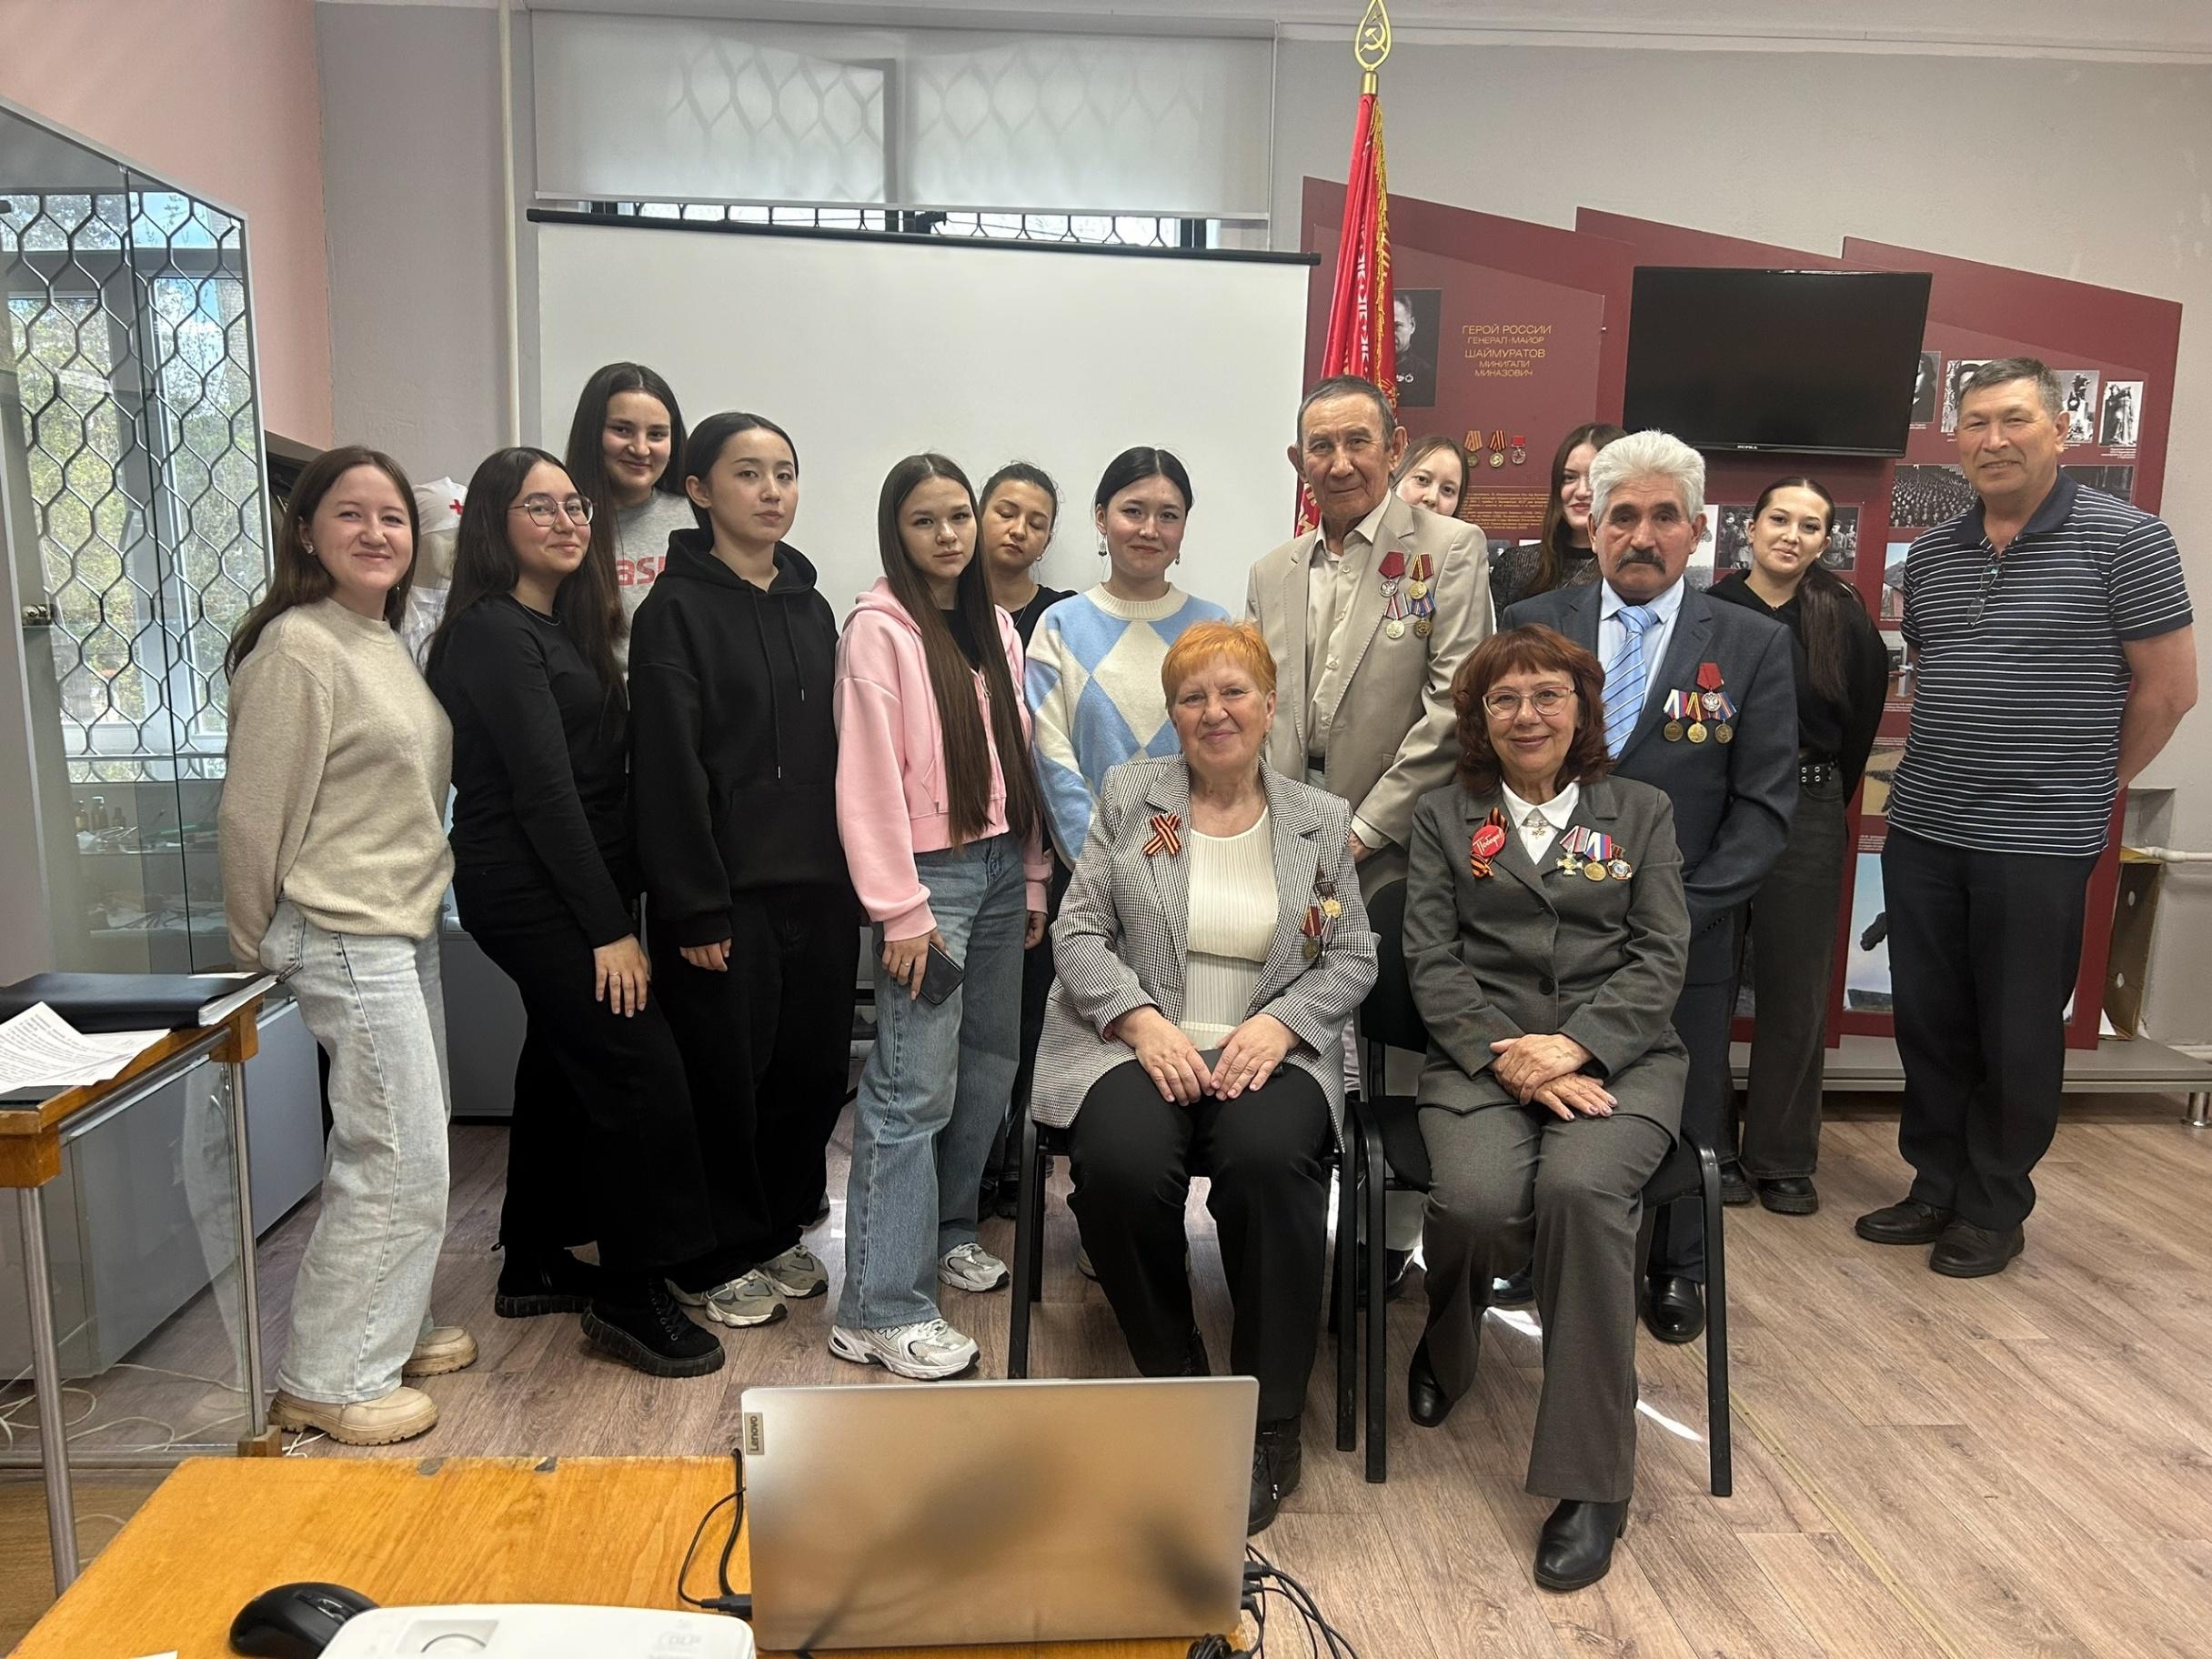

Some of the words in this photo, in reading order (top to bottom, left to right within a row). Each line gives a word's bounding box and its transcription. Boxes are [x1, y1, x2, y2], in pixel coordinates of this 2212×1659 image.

[1462, 324, 1500, 335] ГЕРОЙ
[1502, 325, 1552, 335] РОССИИ
[1464, 347, 1546, 358] ШАЙМУРАТОВ
[1474, 368, 1533, 377] МИНАЗОВИЧ
[749, 1415, 759, 1452] Lenovo
